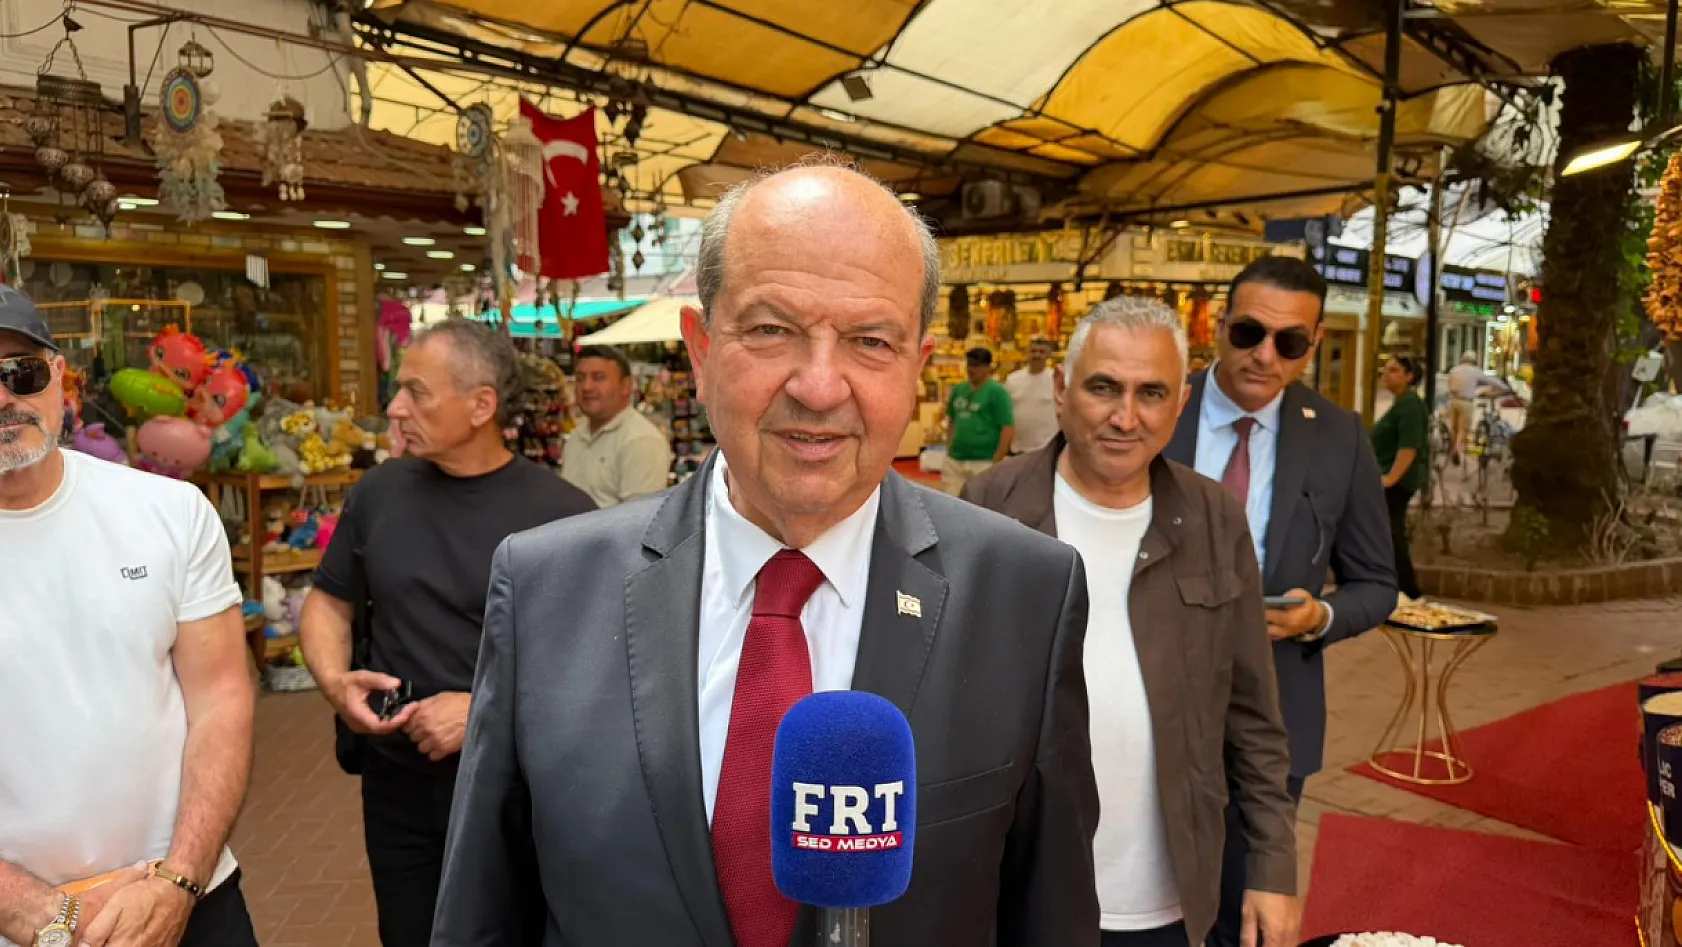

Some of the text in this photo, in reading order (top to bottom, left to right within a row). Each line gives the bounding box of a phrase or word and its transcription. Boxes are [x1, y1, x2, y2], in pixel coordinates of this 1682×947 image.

[792, 780, 904, 835] FRT
[797, 836, 898, 851] SED MEDYA
